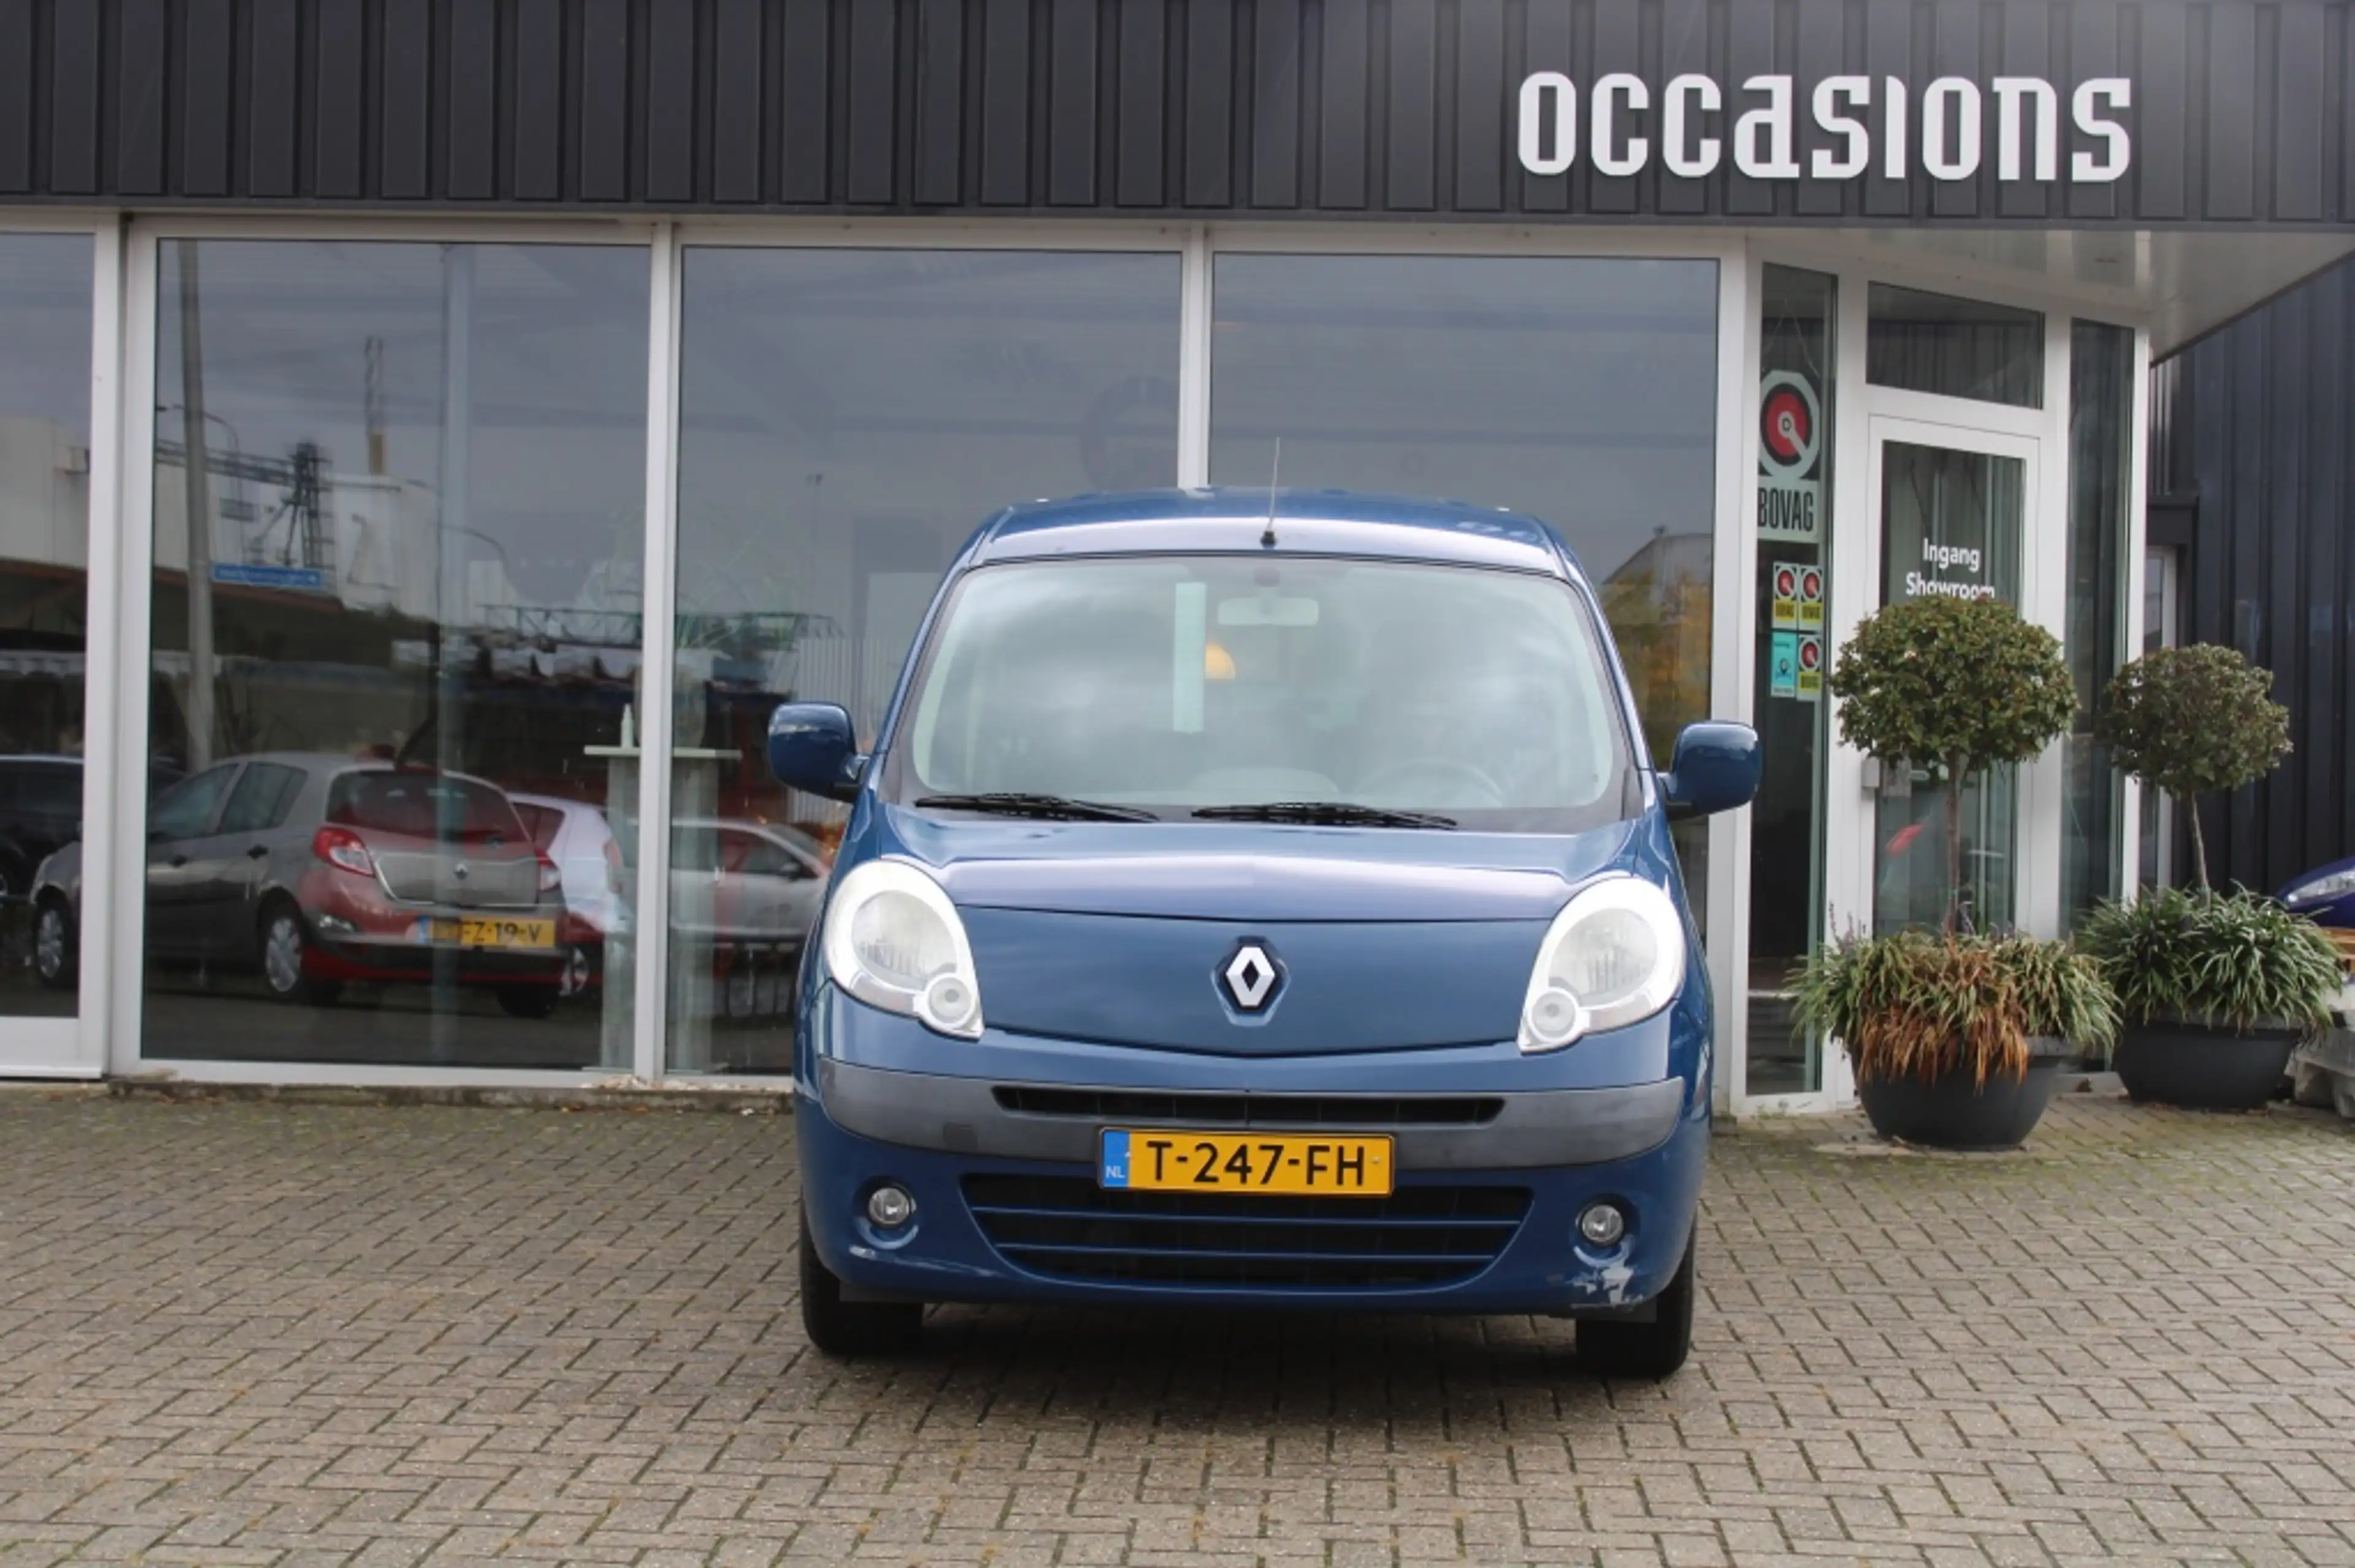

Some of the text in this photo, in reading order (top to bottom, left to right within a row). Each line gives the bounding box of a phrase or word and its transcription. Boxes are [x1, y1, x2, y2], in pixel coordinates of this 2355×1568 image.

[1757, 487, 1813, 532] BOVAG
[1923, 537, 1981, 573] Ingang
[1905, 571, 1996, 600] Showroom
[1105, 1166, 1126, 1178] NL
[1146, 1141, 1365, 1186] T-247-FH
